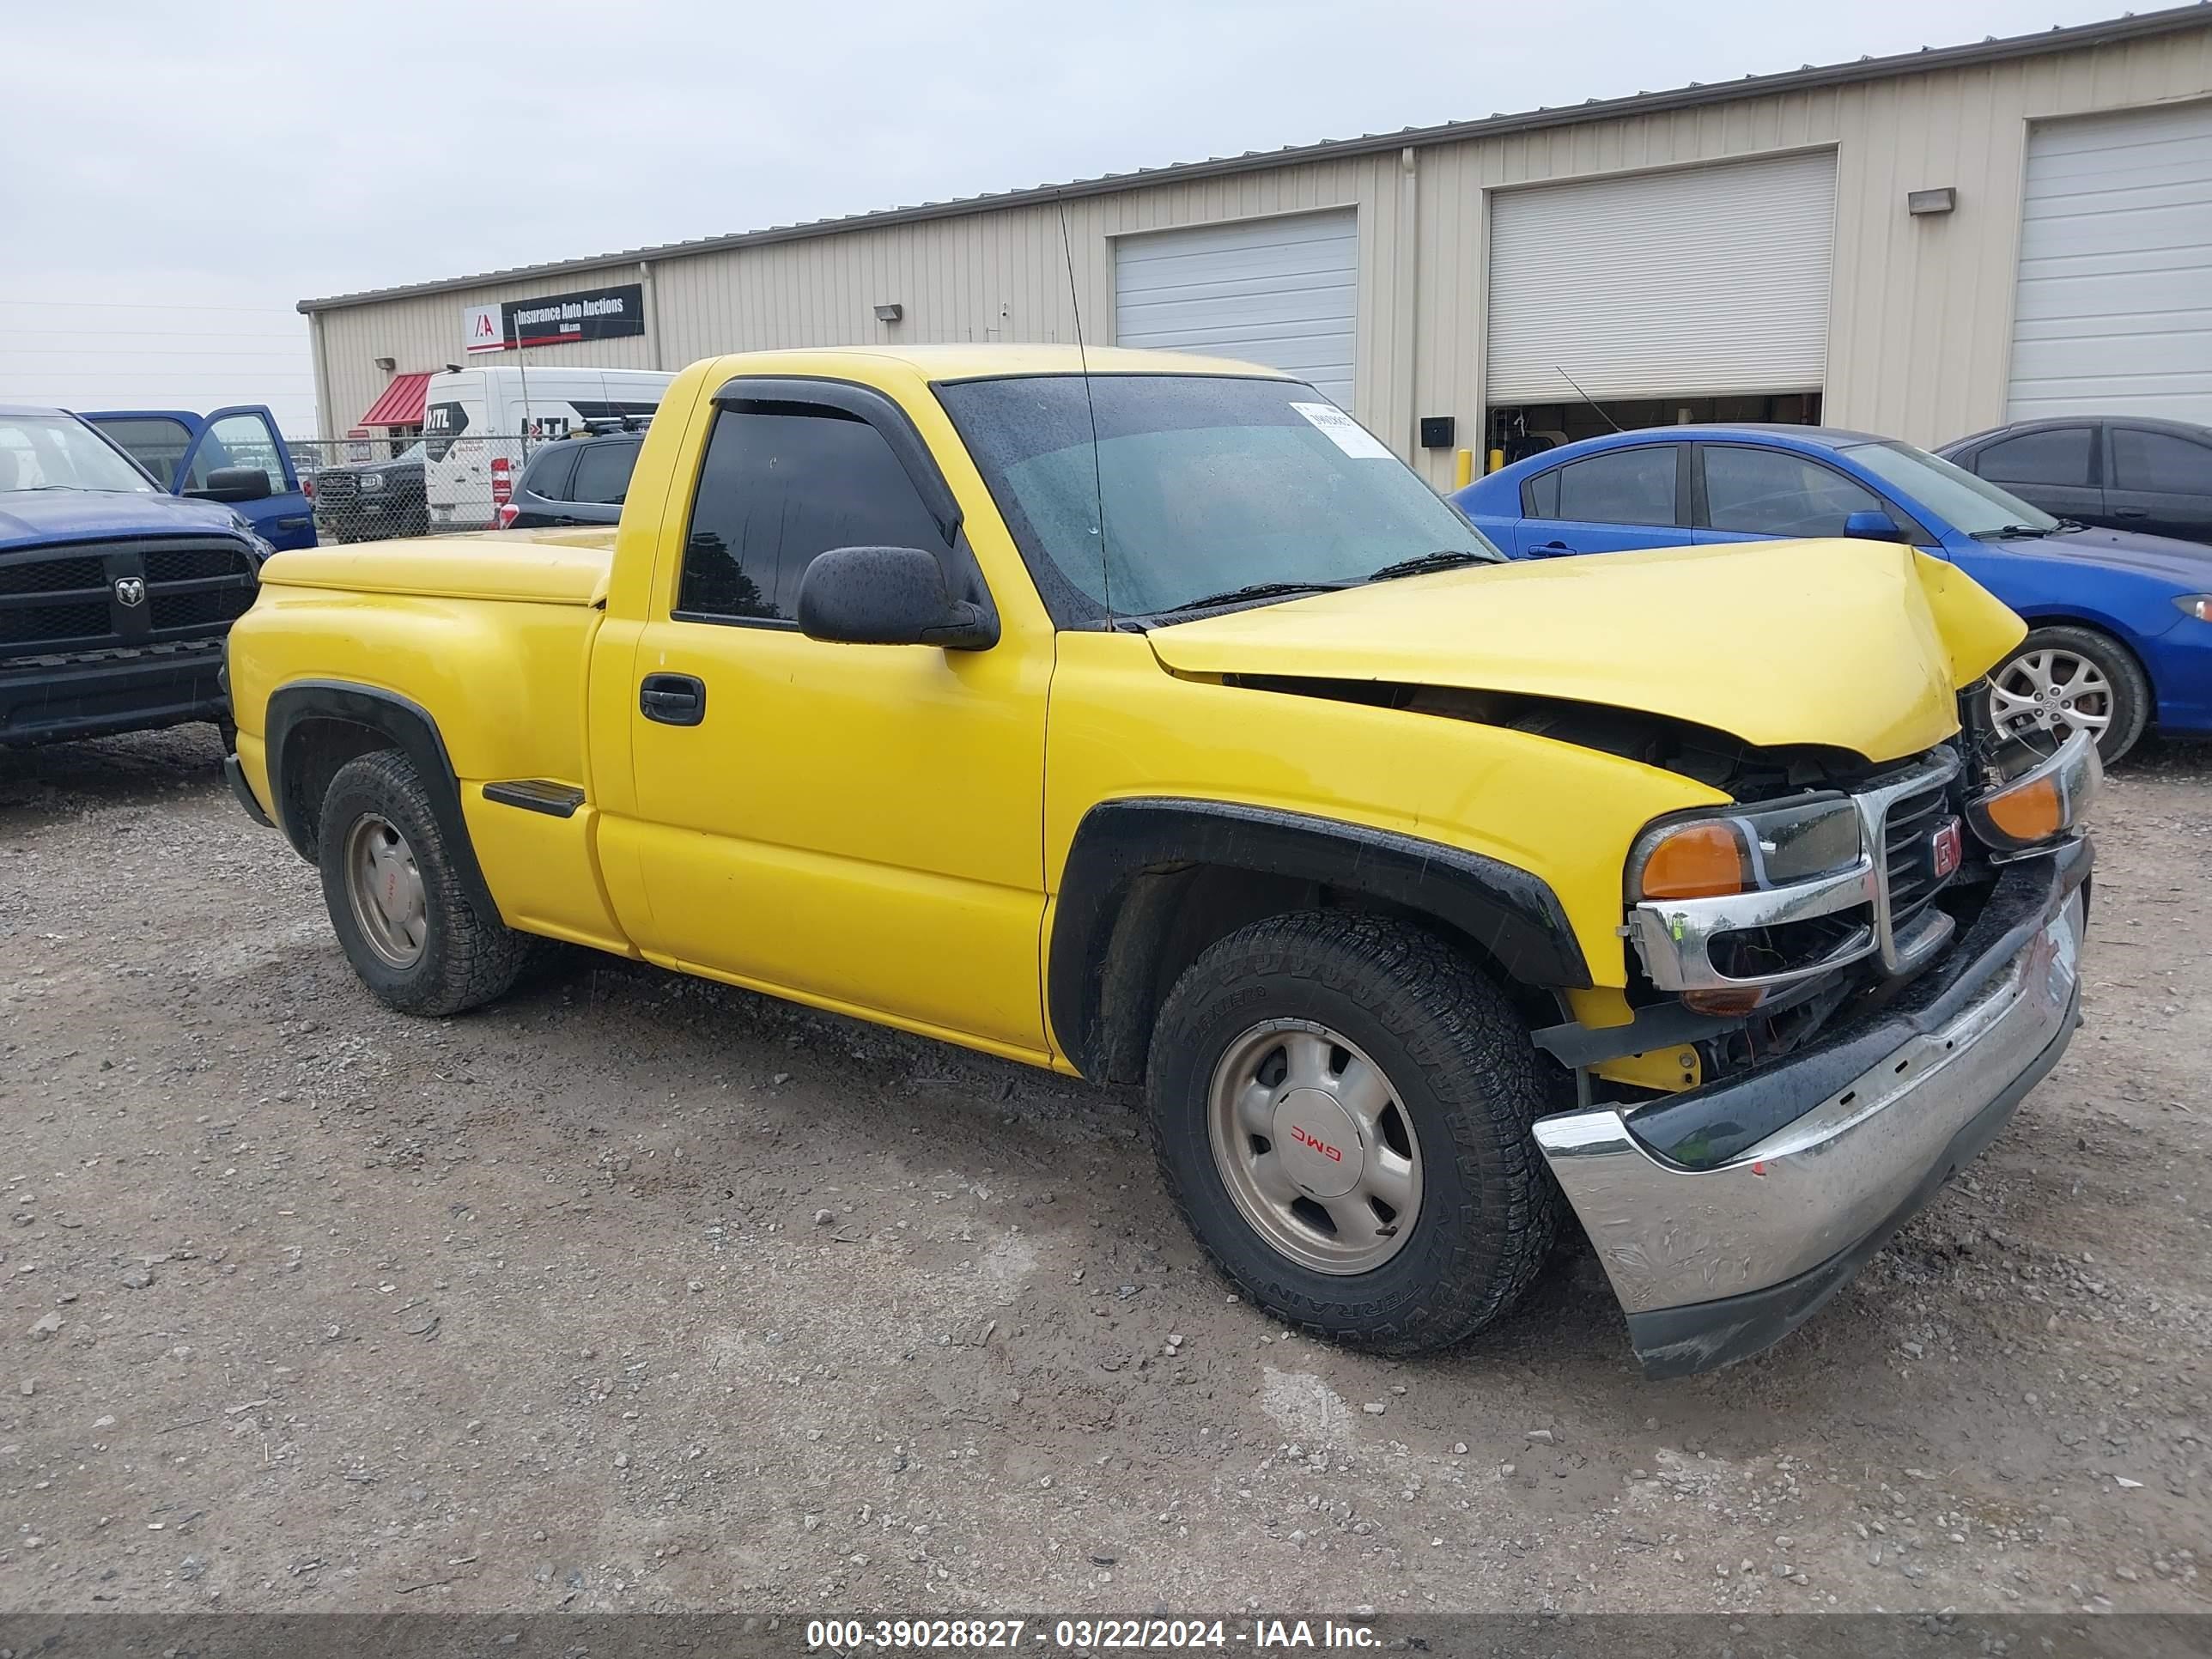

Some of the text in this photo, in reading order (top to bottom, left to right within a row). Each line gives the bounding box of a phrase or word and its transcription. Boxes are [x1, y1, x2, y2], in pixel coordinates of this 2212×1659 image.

[517, 297, 624, 325] Insurance Auto Auctions
[1291, 1125, 1341, 1162] GMC
[1266, 1280, 1422, 1320] TERRAIN
